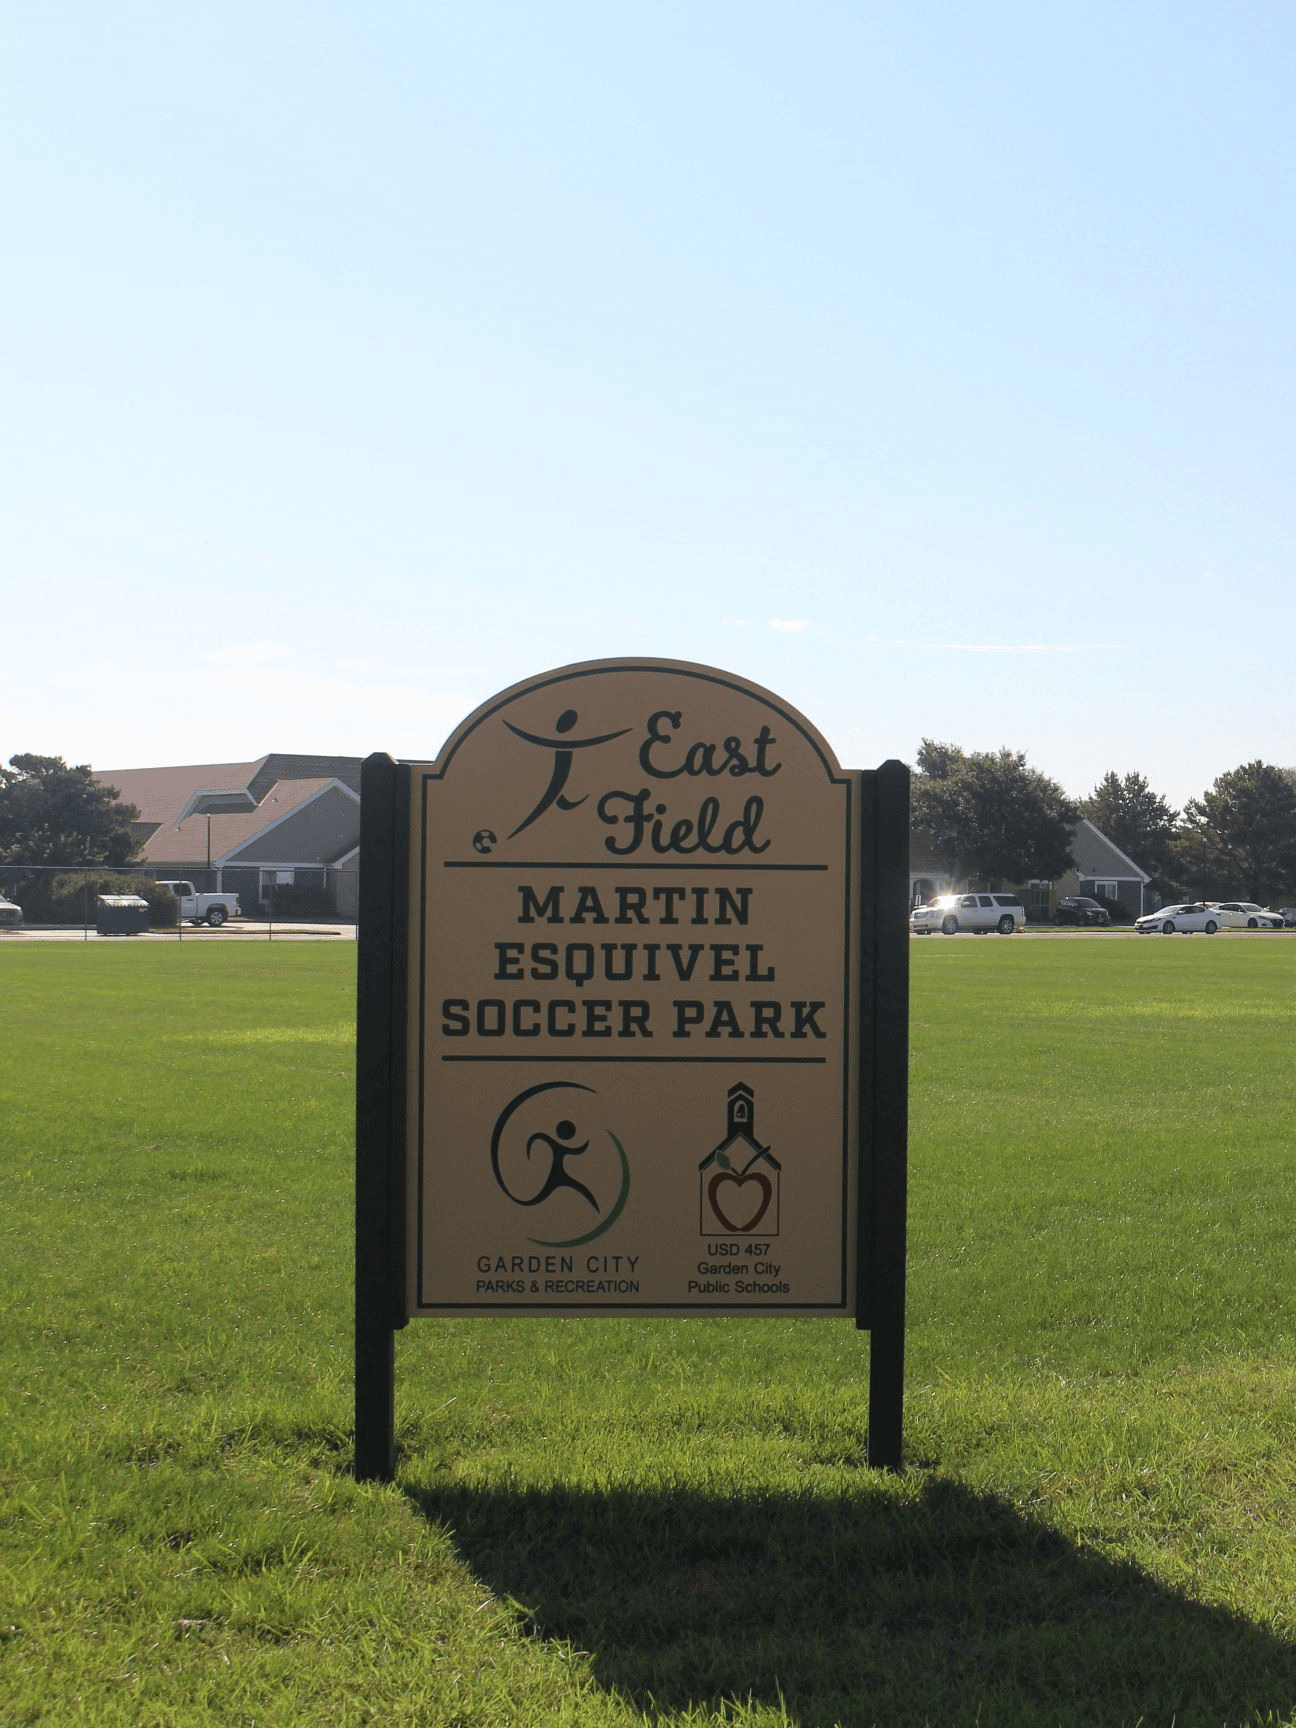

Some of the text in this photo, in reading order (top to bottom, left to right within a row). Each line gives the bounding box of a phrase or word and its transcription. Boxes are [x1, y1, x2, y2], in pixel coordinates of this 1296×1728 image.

[639, 710, 782, 779] East
[596, 788, 772, 856] Field
[517, 885, 753, 925] MARTIN
[494, 942, 776, 987] ESQUIVEL
[442, 999, 827, 1039] SOCCER PARK
[477, 1255, 640, 1274] GARDEN CITY
[707, 1243, 771, 1257] USD 457
[697, 1261, 781, 1277] Garden City
[476, 1279, 640, 1294] PARKS & RECREATION
[687, 1280, 791, 1294] Public Schools
